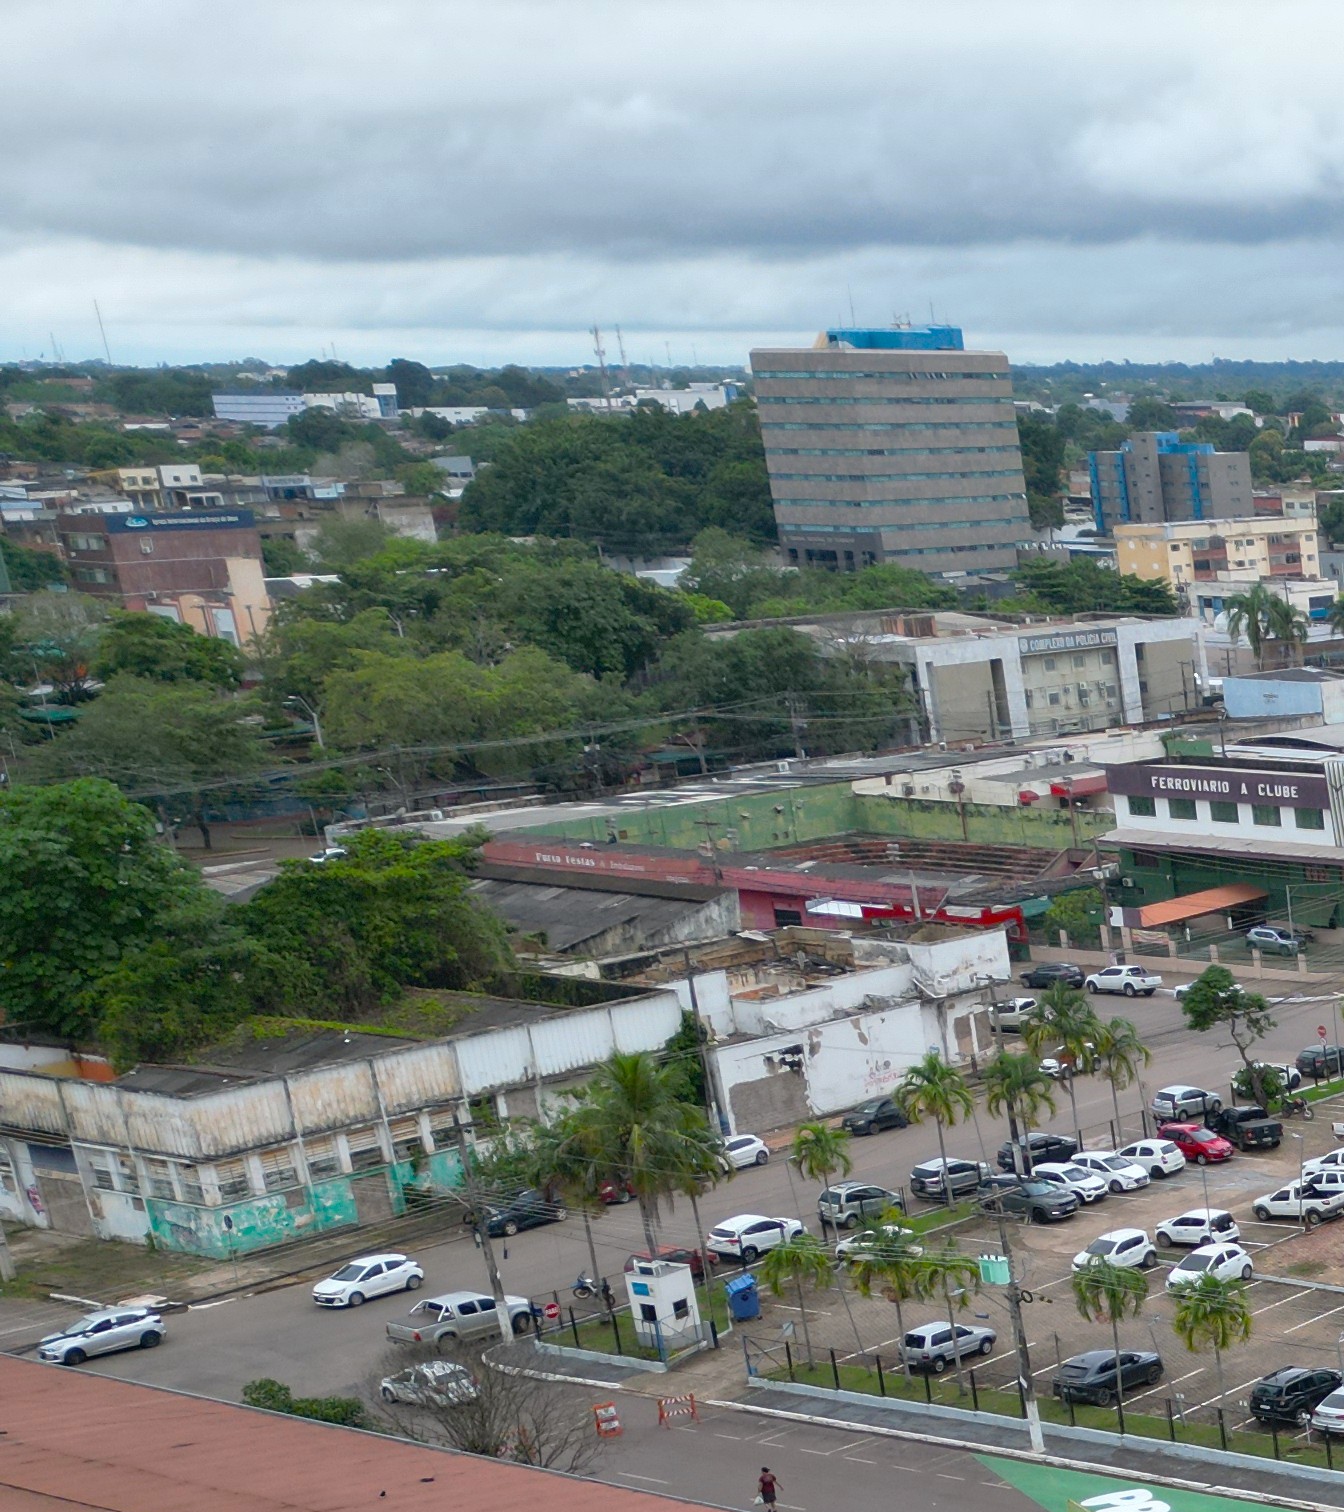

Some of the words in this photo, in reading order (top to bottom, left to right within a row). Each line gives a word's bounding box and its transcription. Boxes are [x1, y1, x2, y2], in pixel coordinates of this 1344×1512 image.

[1151, 776, 1230, 793] FERROVIARIO
[1240, 782, 1248, 795] A
[1257, 783, 1299, 798] CLUBE
